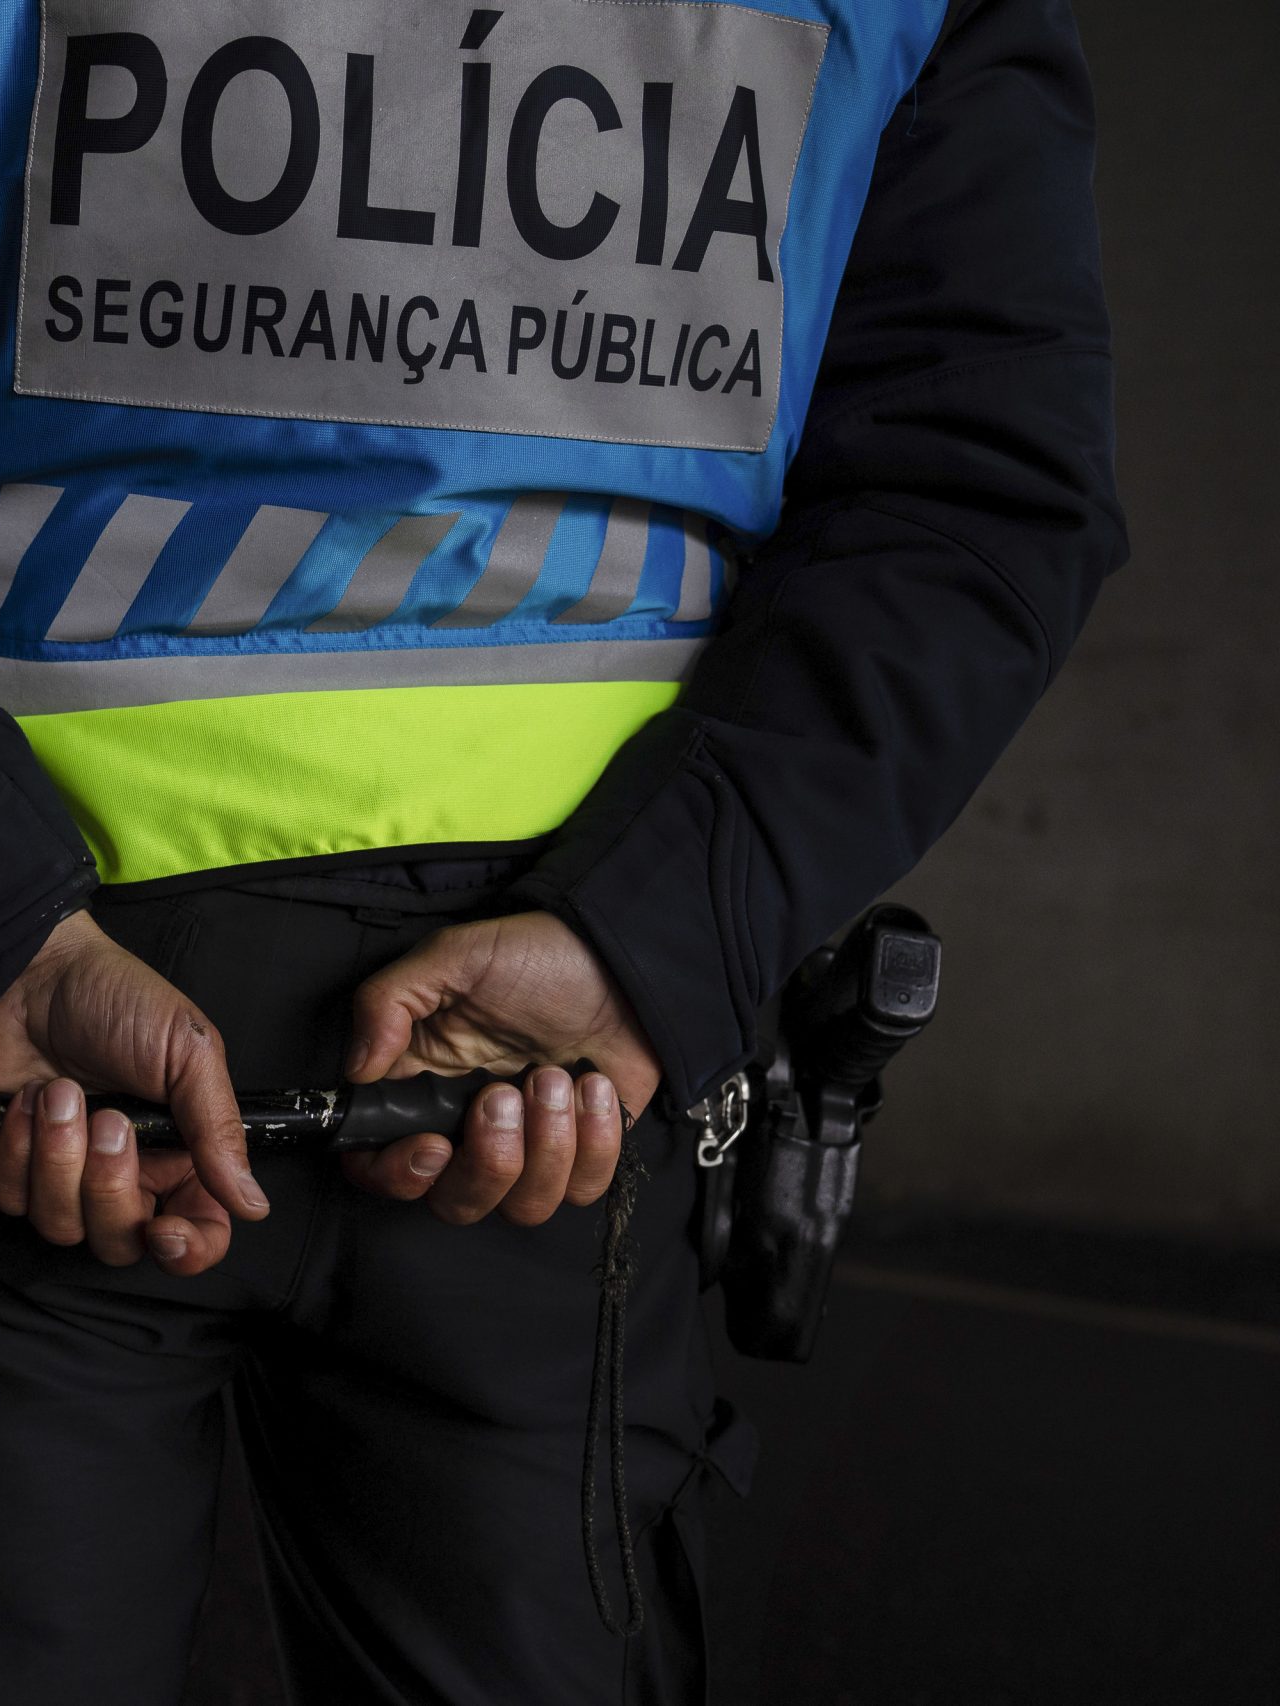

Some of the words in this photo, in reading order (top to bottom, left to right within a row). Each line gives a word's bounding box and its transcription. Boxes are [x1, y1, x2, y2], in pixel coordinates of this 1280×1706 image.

[48, 8, 776, 284] POLÍCIA
[44, 274, 488, 386] SEGURANÇA
[506, 289, 763, 399] PÚBLICA
